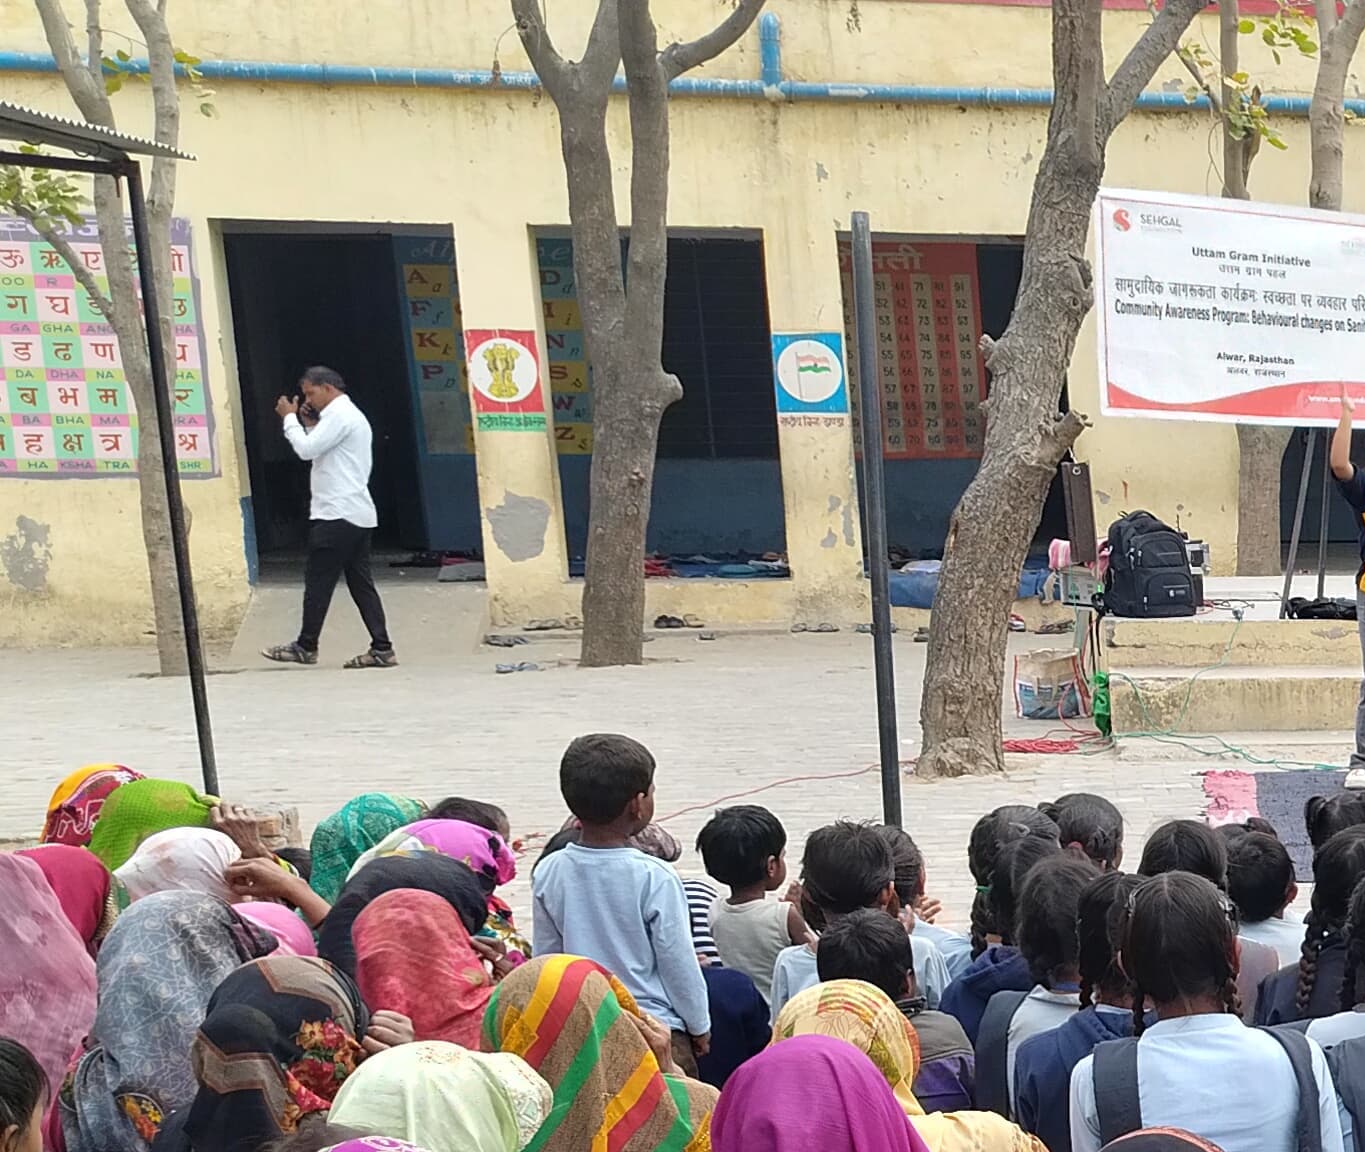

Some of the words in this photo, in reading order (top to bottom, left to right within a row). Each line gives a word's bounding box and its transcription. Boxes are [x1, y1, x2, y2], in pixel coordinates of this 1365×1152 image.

[1140, 213, 1183, 227] SEHGAL
[1191, 246, 1226, 260] Uttam
[1229, 250, 1259, 262] Gram
[1262, 253, 1311, 268] Initiative
[1114, 274, 1165, 298] सामुदायिक
[1168, 281, 1217, 300] जागरूकता
[1262, 290, 1297, 306] स्वच्छता
[1300, 293, 1313, 308] पर
[1316, 294, 1348, 312] व्यवहार
[5, 295, 28, 315] ग
[45, 295, 70, 315] घ
[918, 316, 930, 326] 73
[1114, 299, 1163, 321] Community
[1165, 302, 1211, 321] Awareness
[1212, 306, 1250, 326] Program:
[1251, 309, 1299, 328] Behavioural
[1301, 313, 1333, 333] changes
[1334, 320, 1346, 332] on
[10, 323, 32, 333] GA
[42, 323, 74, 333] GHA
[415, 332, 441, 348] K
[546, 334, 566, 349] N
[880, 333, 893, 343] 54
[11, 341, 33, 362] ड
[52, 342, 73, 362] ढ
[90, 343, 115, 362] ण
[881, 350, 894, 360] 55
[921, 350, 933, 360] 75
[1216, 351, 1247, 363] Alwar,
[1249, 353, 1295, 366] Rajasthan
[15, 369, 34, 379] DA
[51, 370, 79, 379] DHA
[96, 370, 115, 379] NA
[421, 365, 444, 380] P
[549, 366, 569, 380] S
[922, 367, 935, 377] 76
[885, 383, 897, 393] 57
[924, 383, 935, 393] 77
[17, 387, 38, 407] ब
[57, 387, 80, 407] भ
[96, 388, 118, 407] म
[22, 415, 40, 425] BA
[56, 415, 85, 425] BHA
[100, 416, 121, 425] MA
[555, 427, 575, 441] Z
[23, 434, 44, 455] ह
[27, 461, 49, 470] HA
[104, 461, 130, 470] TRA
